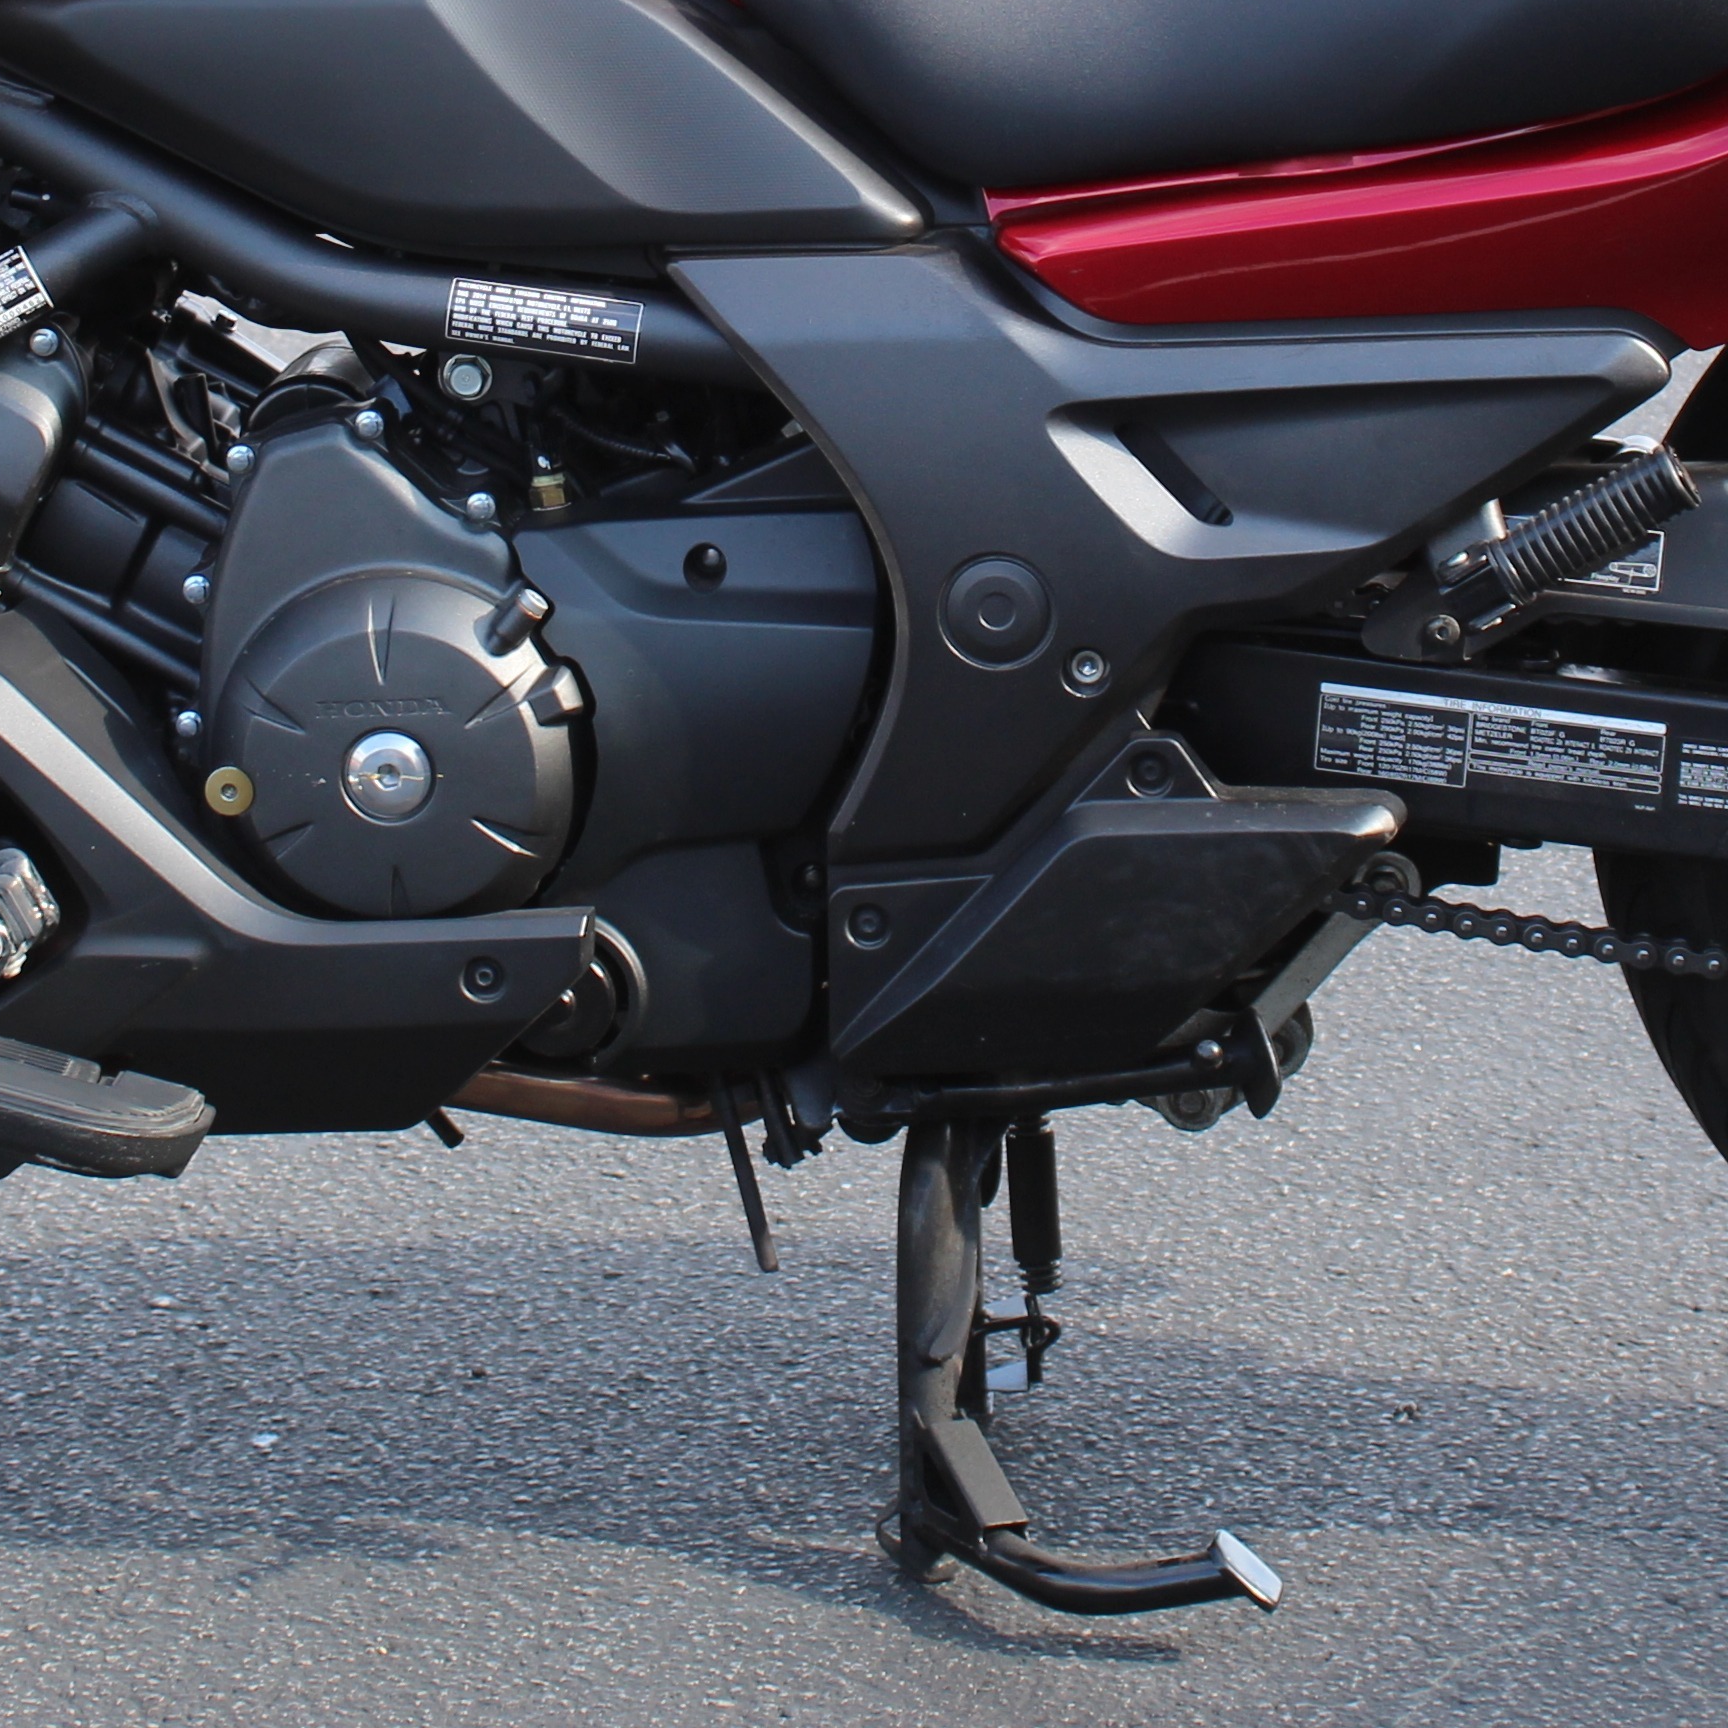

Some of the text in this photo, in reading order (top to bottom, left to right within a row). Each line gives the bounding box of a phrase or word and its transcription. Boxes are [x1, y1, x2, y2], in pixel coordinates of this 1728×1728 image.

[315, 698, 451, 721] HONDA
[1443, 698, 1541, 718] TIRE INFORMATION
